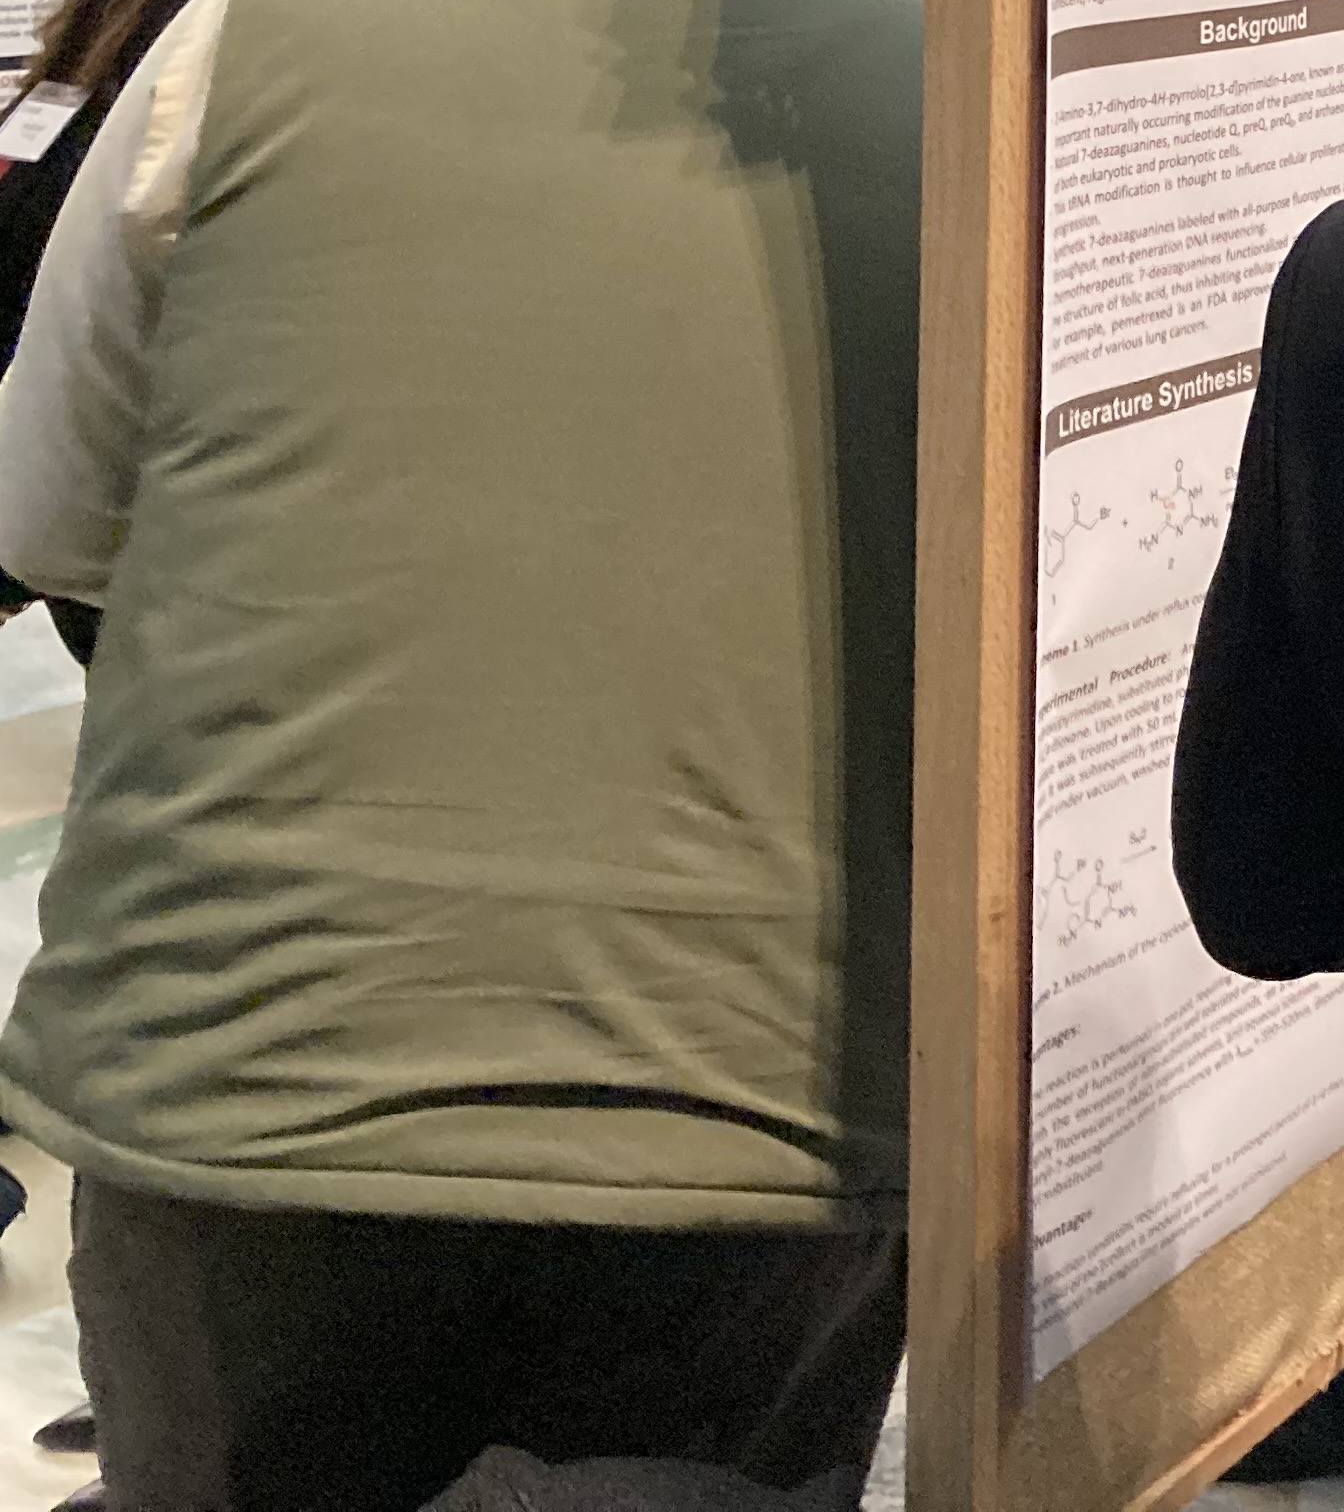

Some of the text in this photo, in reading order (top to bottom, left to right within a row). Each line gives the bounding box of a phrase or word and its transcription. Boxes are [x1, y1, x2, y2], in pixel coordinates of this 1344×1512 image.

[1200, 7, 1308, 45] Background
[1093, 95, 1281, 138] naturally occurring modification of the
[1081, 127, 1227, 162] 7-deazaguanines, nucleotide
[1080, 143, 1242, 185] eukaryotic and prokaryotic cells.
[1094, 158, 1276, 204] modification is thought to influence
[1090, 197, 1290, 248] 7-deazaguanines labeled with all-purpose
[1186, 231, 1210, 249] DNA
[1107, 296, 1118, 311] of
[1111, 291, 1227, 333] pemetrexed FDA
[1105, 333, 1143, 356] various
[1058, 361, 1253, 438] Literature Synthesis
[1083, 620, 1130, 649] Synthesis
[1132, 609, 1160, 631] under
[1109, 652, 1171, 684] Procedure:
[1094, 712, 1123, 734] Upon
[1124, 697, 1160, 723] cooling
[1080, 735, 1118, 761] treated
[1121, 725, 1144, 743] with
[1064, 952, 1127, 989] Mechanism
